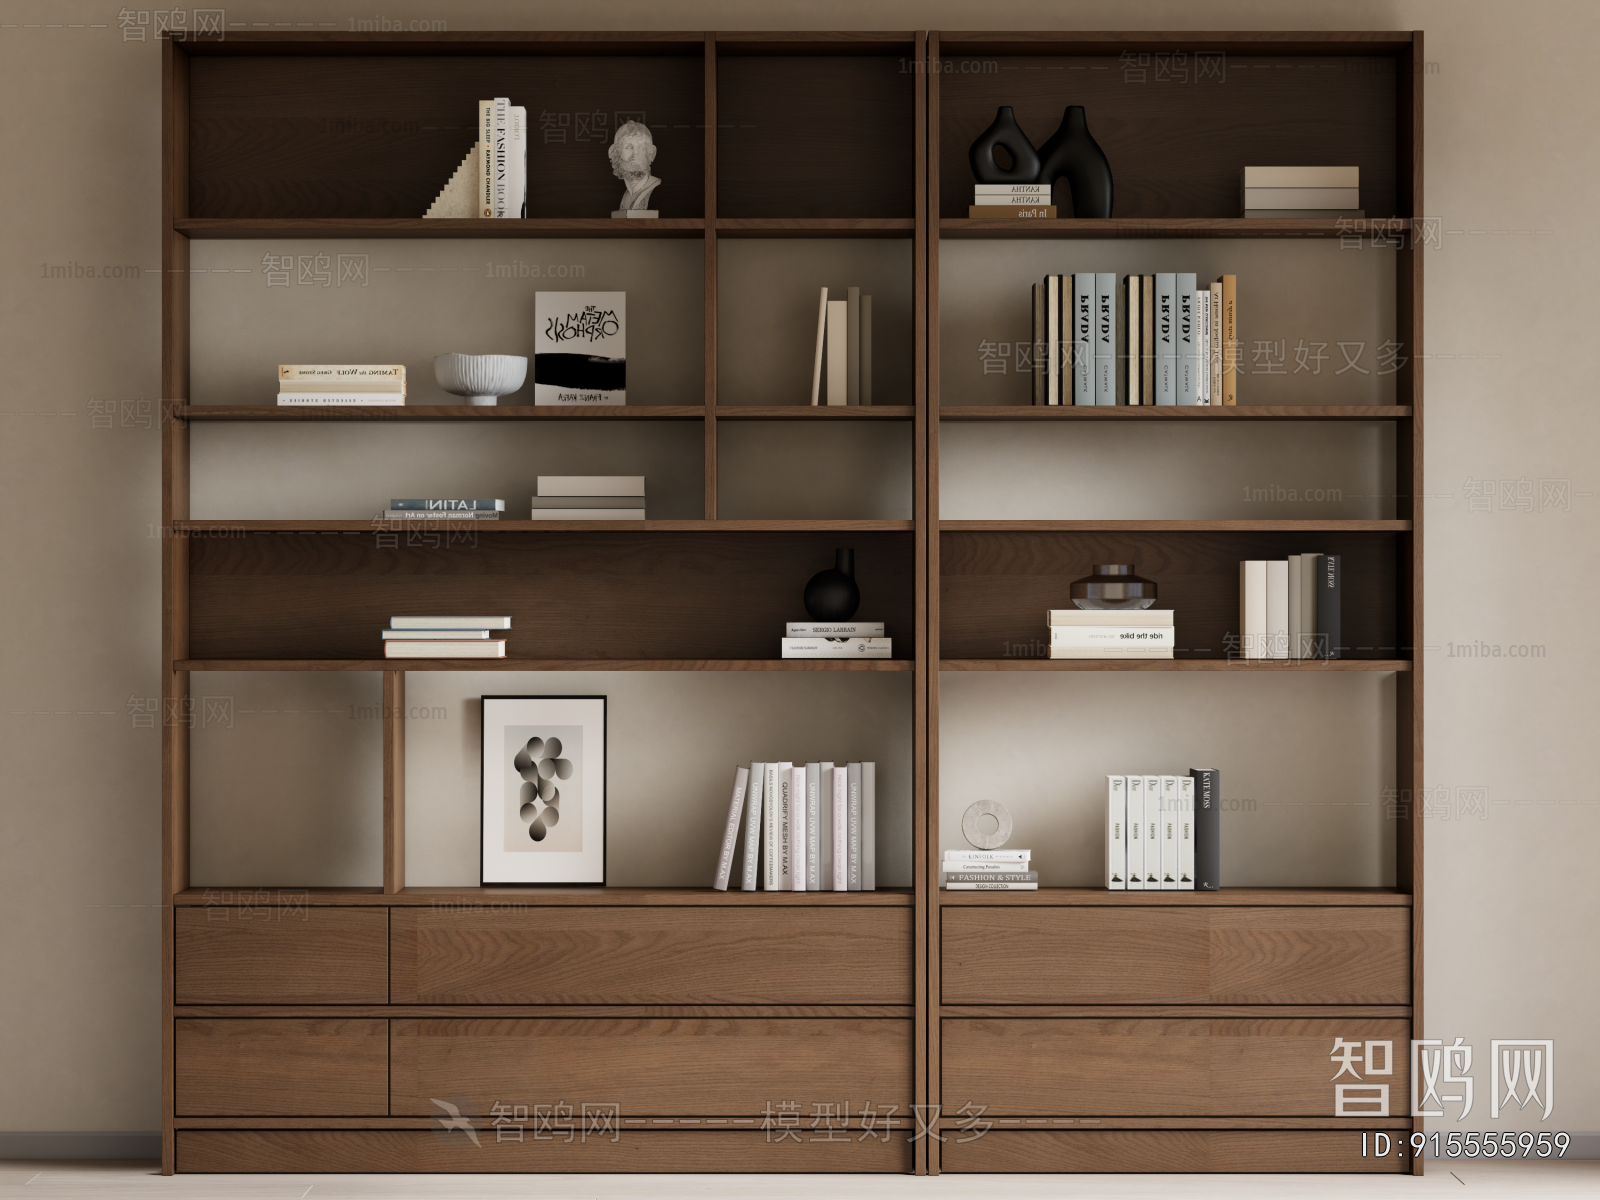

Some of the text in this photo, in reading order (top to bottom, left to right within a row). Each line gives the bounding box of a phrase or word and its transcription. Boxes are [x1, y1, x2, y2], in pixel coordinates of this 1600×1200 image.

[497, 99, 506, 218] THE FASHION BOOK
[719, 786, 741, 880] MATERIAL EDITOR BY M.AX
[782, 845, 788, 855] BY
[748, 854, 753, 864] BY
[809, 854, 815, 863] BY
[851, 854, 856, 863] BY
